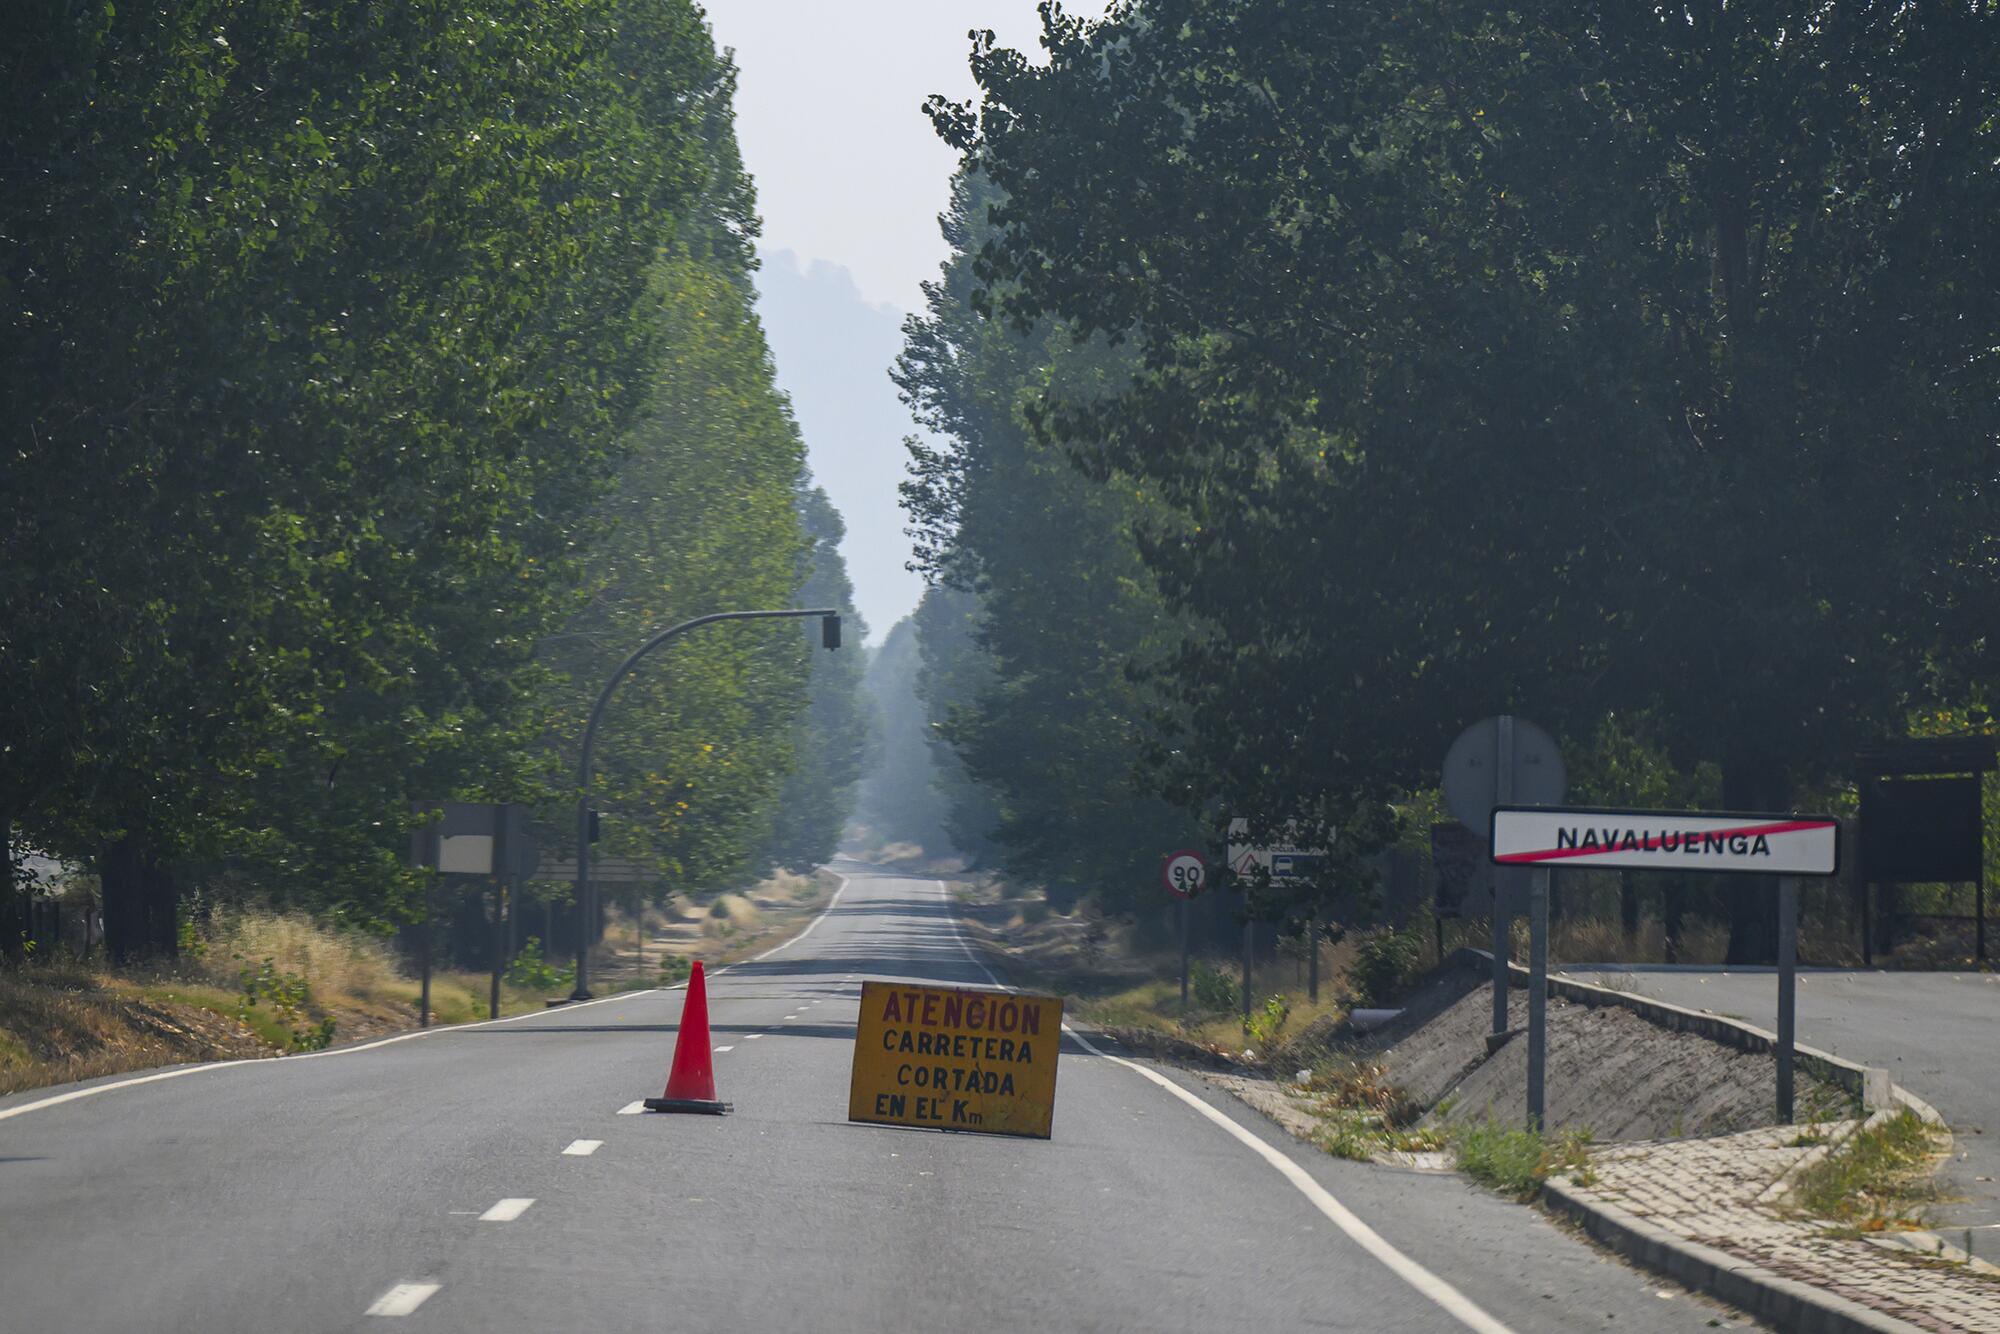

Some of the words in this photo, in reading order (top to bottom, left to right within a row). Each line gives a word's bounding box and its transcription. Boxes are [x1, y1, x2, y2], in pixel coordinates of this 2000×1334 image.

[1557, 827, 1770, 857] NAVALUENGA
[1174, 866, 1200, 882] 90
[882, 991, 1040, 1036] ATENCIÓN
[883, 1029, 1032, 1064] CARRETERA
[897, 1064, 1015, 1097] CORTADA
[875, 1093, 906, 1118] EN
[915, 1096, 943, 1121] EL
[952, 1099, 983, 1125] Km
